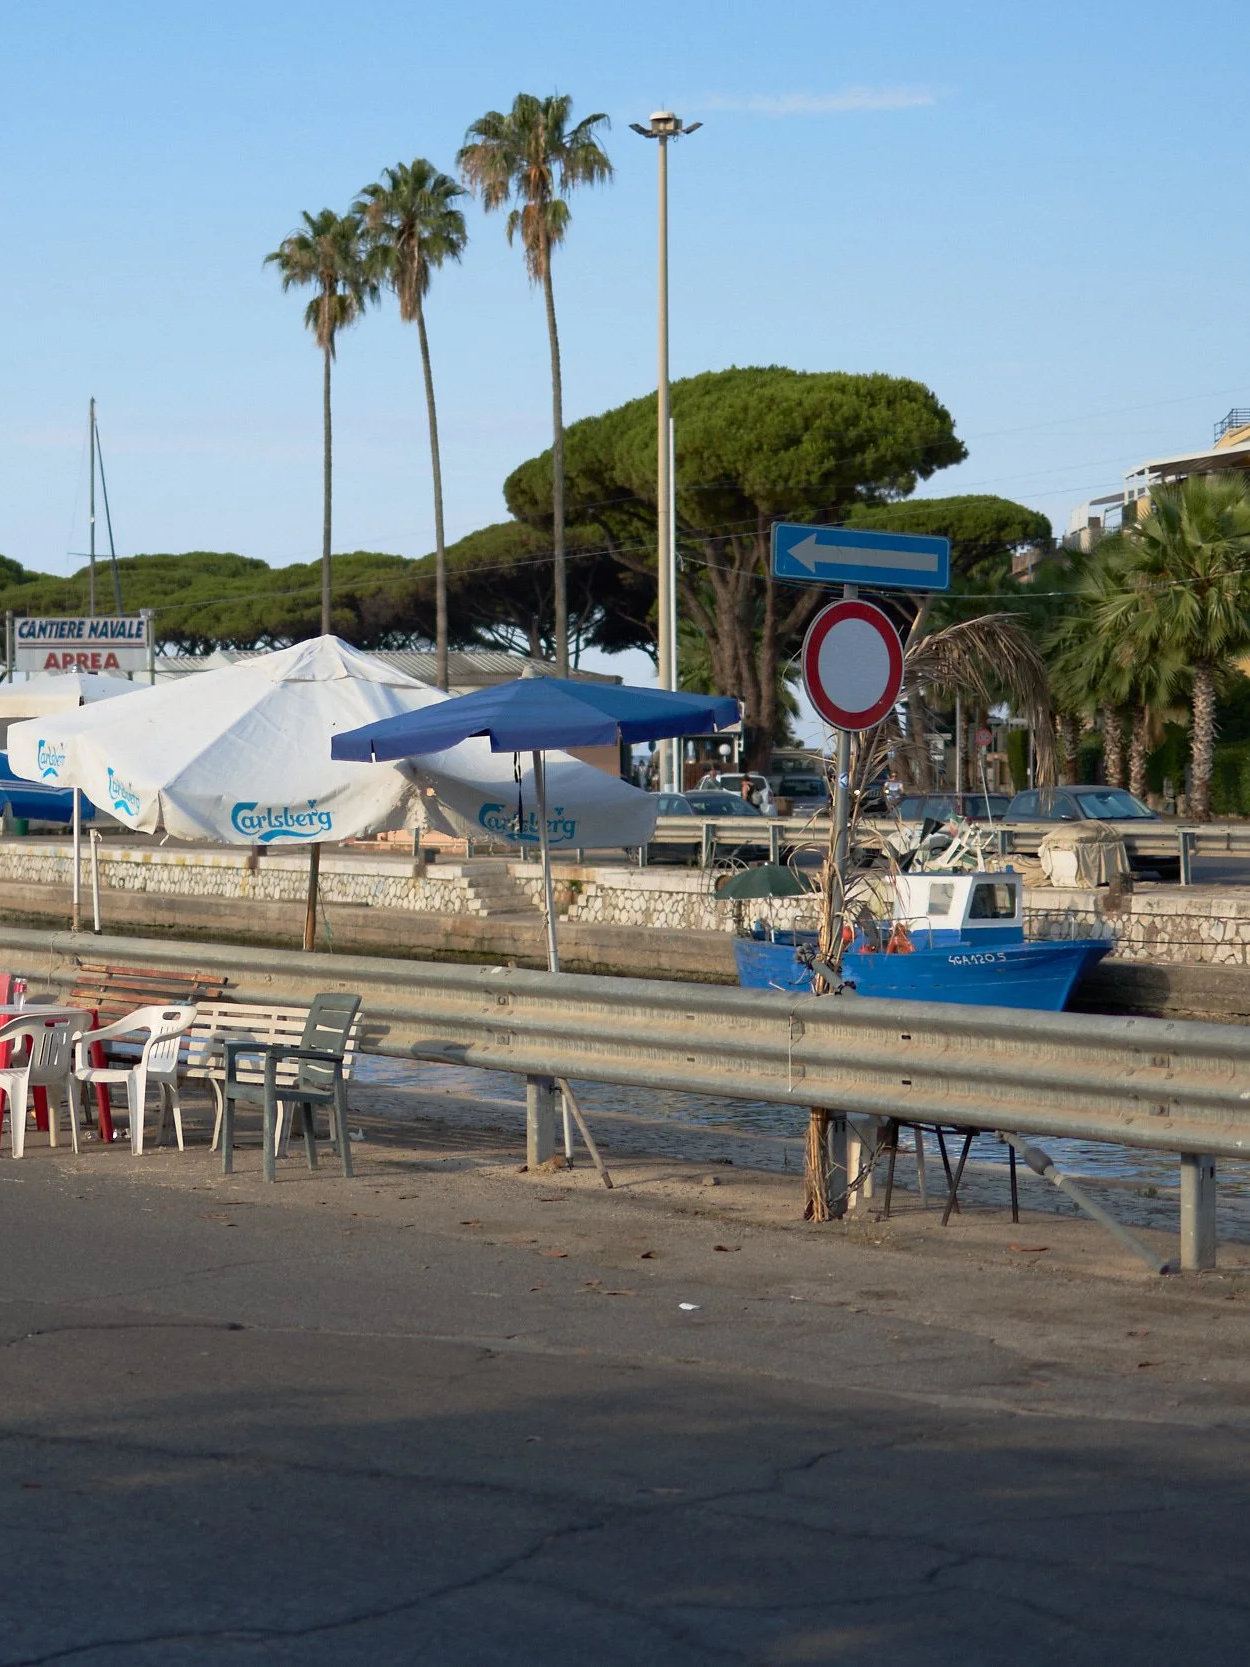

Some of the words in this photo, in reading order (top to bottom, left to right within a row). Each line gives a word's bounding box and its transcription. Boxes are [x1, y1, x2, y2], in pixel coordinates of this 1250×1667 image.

[18, 620, 86, 639] CANTIERE
[88, 620, 144, 639] NAVALE
[43, 652, 120, 670] APREA
[231, 802, 332, 836] Carlsberg
